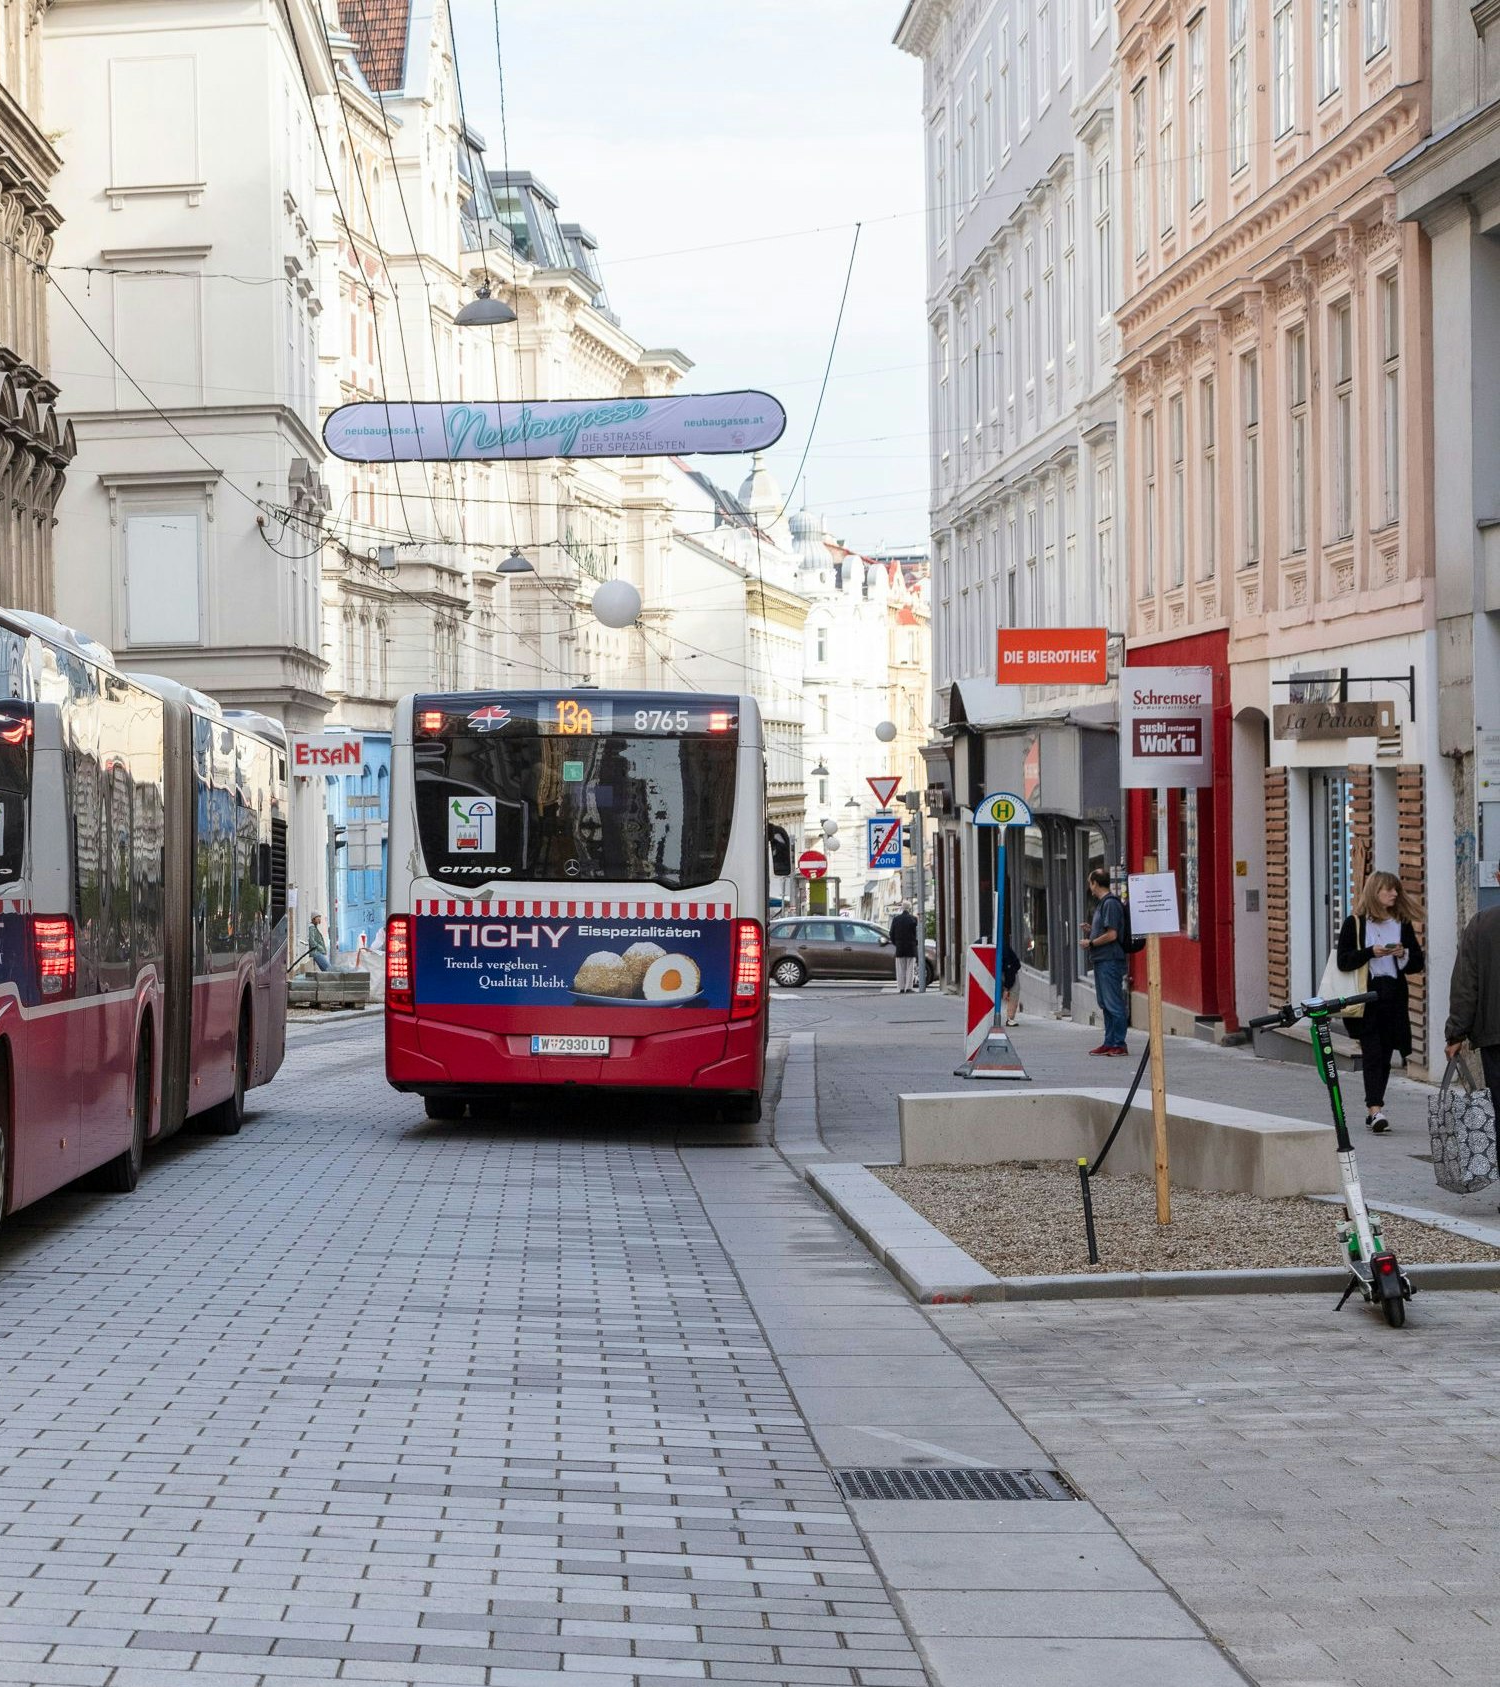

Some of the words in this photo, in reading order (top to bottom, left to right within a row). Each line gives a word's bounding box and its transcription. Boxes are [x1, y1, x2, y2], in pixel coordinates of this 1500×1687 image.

[684, 416, 764, 428] neubaugasse.at
[345, 426, 425, 437] neubaugasse.at
[449, 401, 649, 457] Neubaugasse
[582, 433, 599, 442] DIE
[603, 431, 652, 442] STRASSE
[582, 443, 603, 452] DER
[607, 440, 686, 452] SPEZIALISTEN
[1003, 650, 1024, 664] DIE
[1133, 689, 1202, 705] Schremser
[557, 700, 592, 735] 13A
[634, 710, 689, 731] 8765
[1283, 713, 1307, 730] La
[1315, 711, 1376, 729] Pausa
[1139, 722, 1167, 733] sushi
[887, 842, 898, 853] 20
[875, 856, 897, 865] Zone
[439, 866, 512, 874] CITARO
[444, 924, 570, 948] TICHY
[578, 925, 701, 939] Eisspezialitäten
[444, 957, 483, 970] Trends
[487, 957, 539, 973] vergehen
[479, 974, 528, 988] Qualität
[531, 975, 568, 988] bleibt.
[541, 1038, 550, 1050] W
[559, 1039, 589, 1051] 2930
